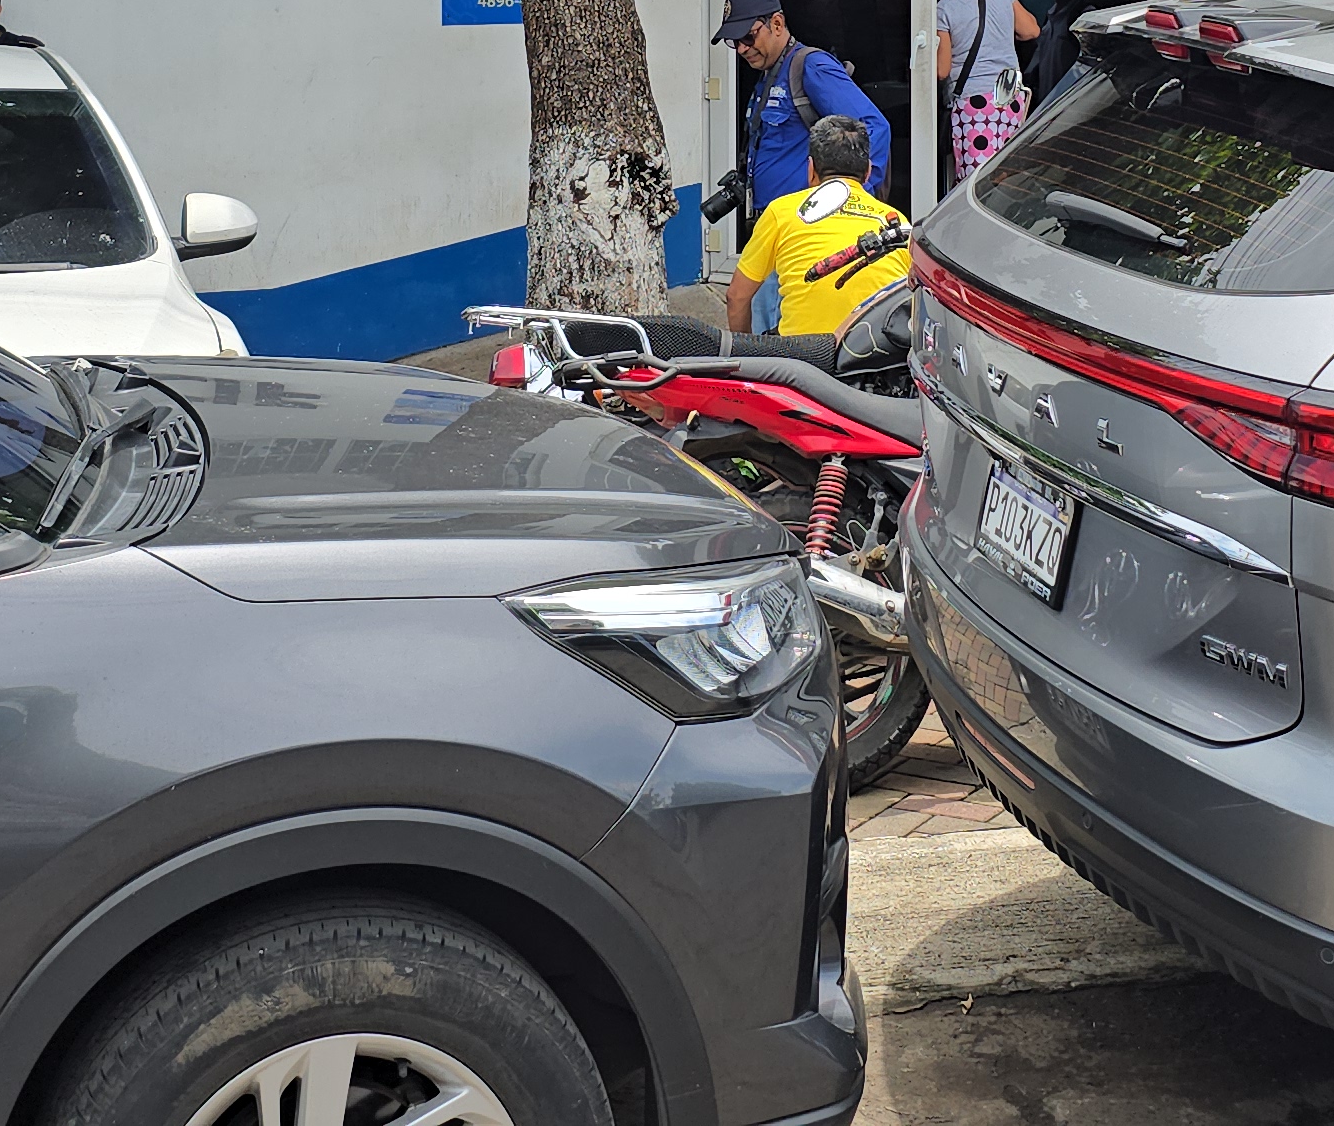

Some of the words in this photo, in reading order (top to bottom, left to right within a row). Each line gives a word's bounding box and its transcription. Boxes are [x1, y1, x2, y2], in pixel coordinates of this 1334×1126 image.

[923, 317, 1124, 457] HAVAL
[984, 480, 1063, 578] P103KZQ
[1199, 634, 1290, 690] GWM
